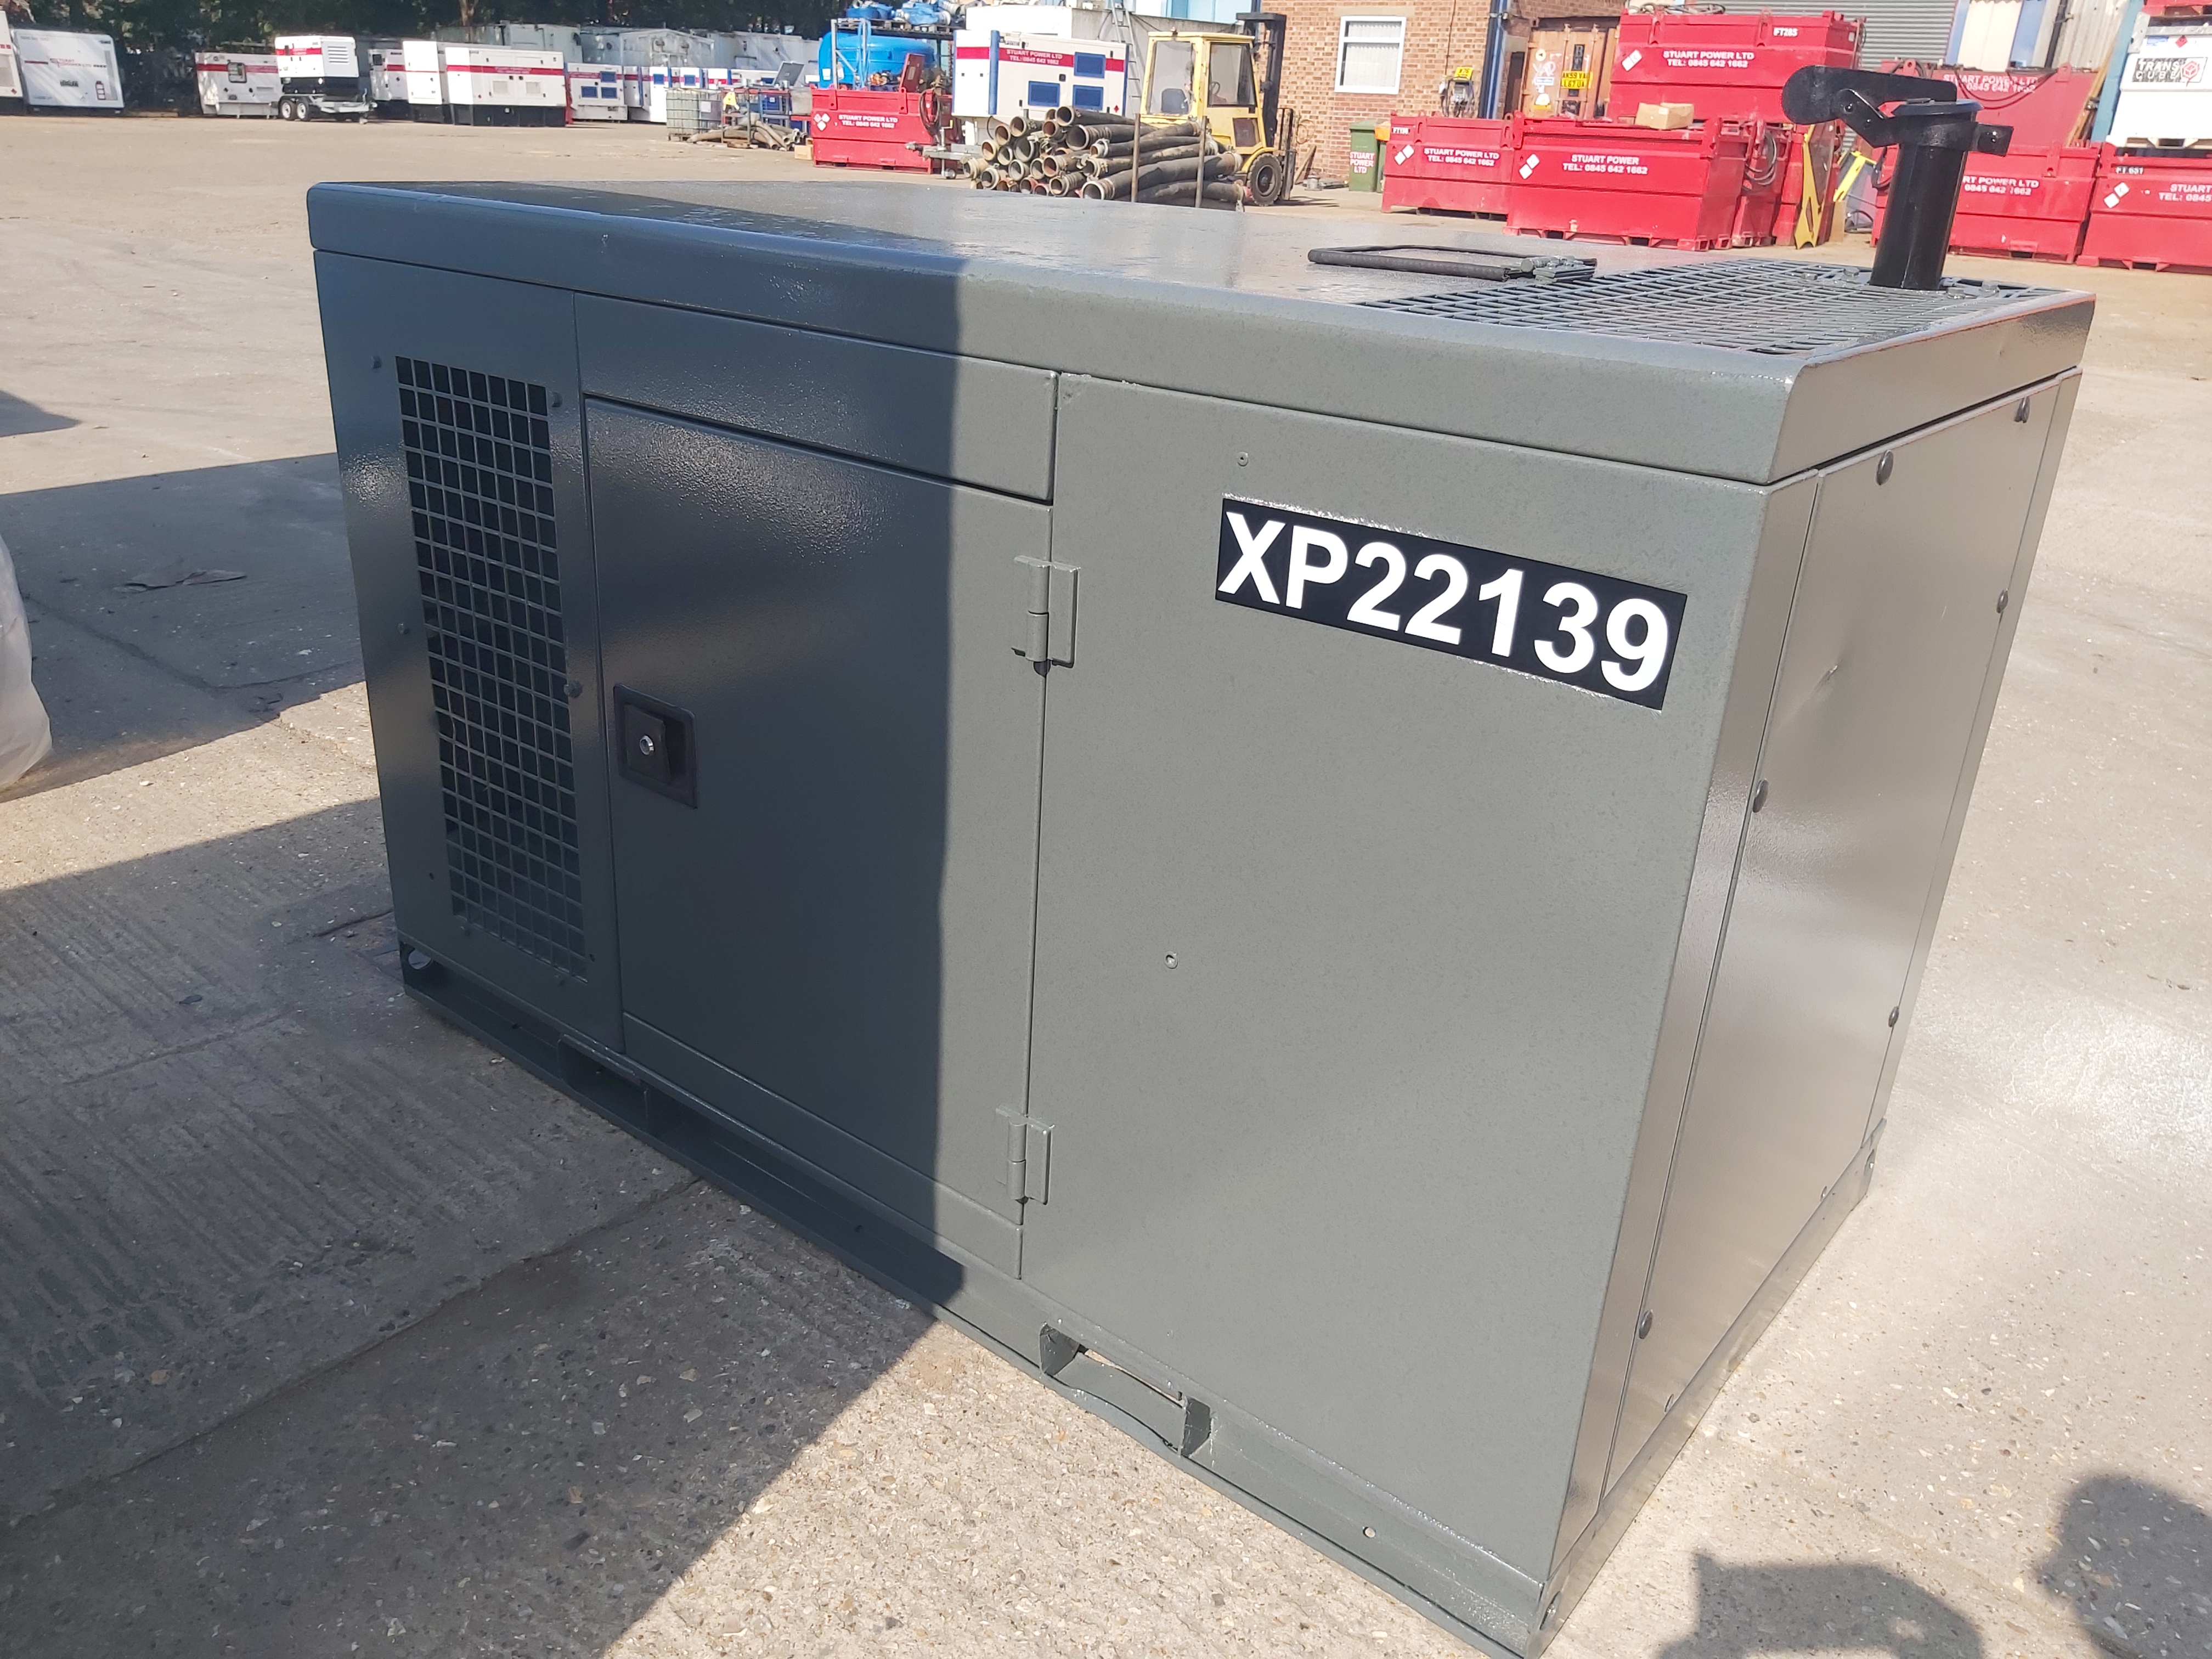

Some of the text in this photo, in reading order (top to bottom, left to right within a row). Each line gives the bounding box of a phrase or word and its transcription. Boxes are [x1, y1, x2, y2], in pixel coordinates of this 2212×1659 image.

[1667, 59, 1686, 67] TEL:
[1709, 59, 1725, 67] 642
[2138, 59, 2180, 71] TRANS
[2136, 71, 2176, 80] CUBE
[1350, 151, 1375, 160] STUART
[1424, 148, 1454, 156] STUART
[1455, 150, 1483, 158] POWER
[1350, 159, 1374, 167] POWER
[1571, 154, 1639, 165] STUART POWER
[1562, 163, 1583, 171] TEL:
[1584, 164, 1606, 172] 0845
[1626, 166, 1648, 174] 1662
[1978, 177, 2017, 187] POWER
[2018, 179, 2039, 188] LTD
[2170, 184, 2212, 193] STUART
[2158, 192, 2212, 202] TEL: 0845
[1217, 511, 1668, 692] XP22139
